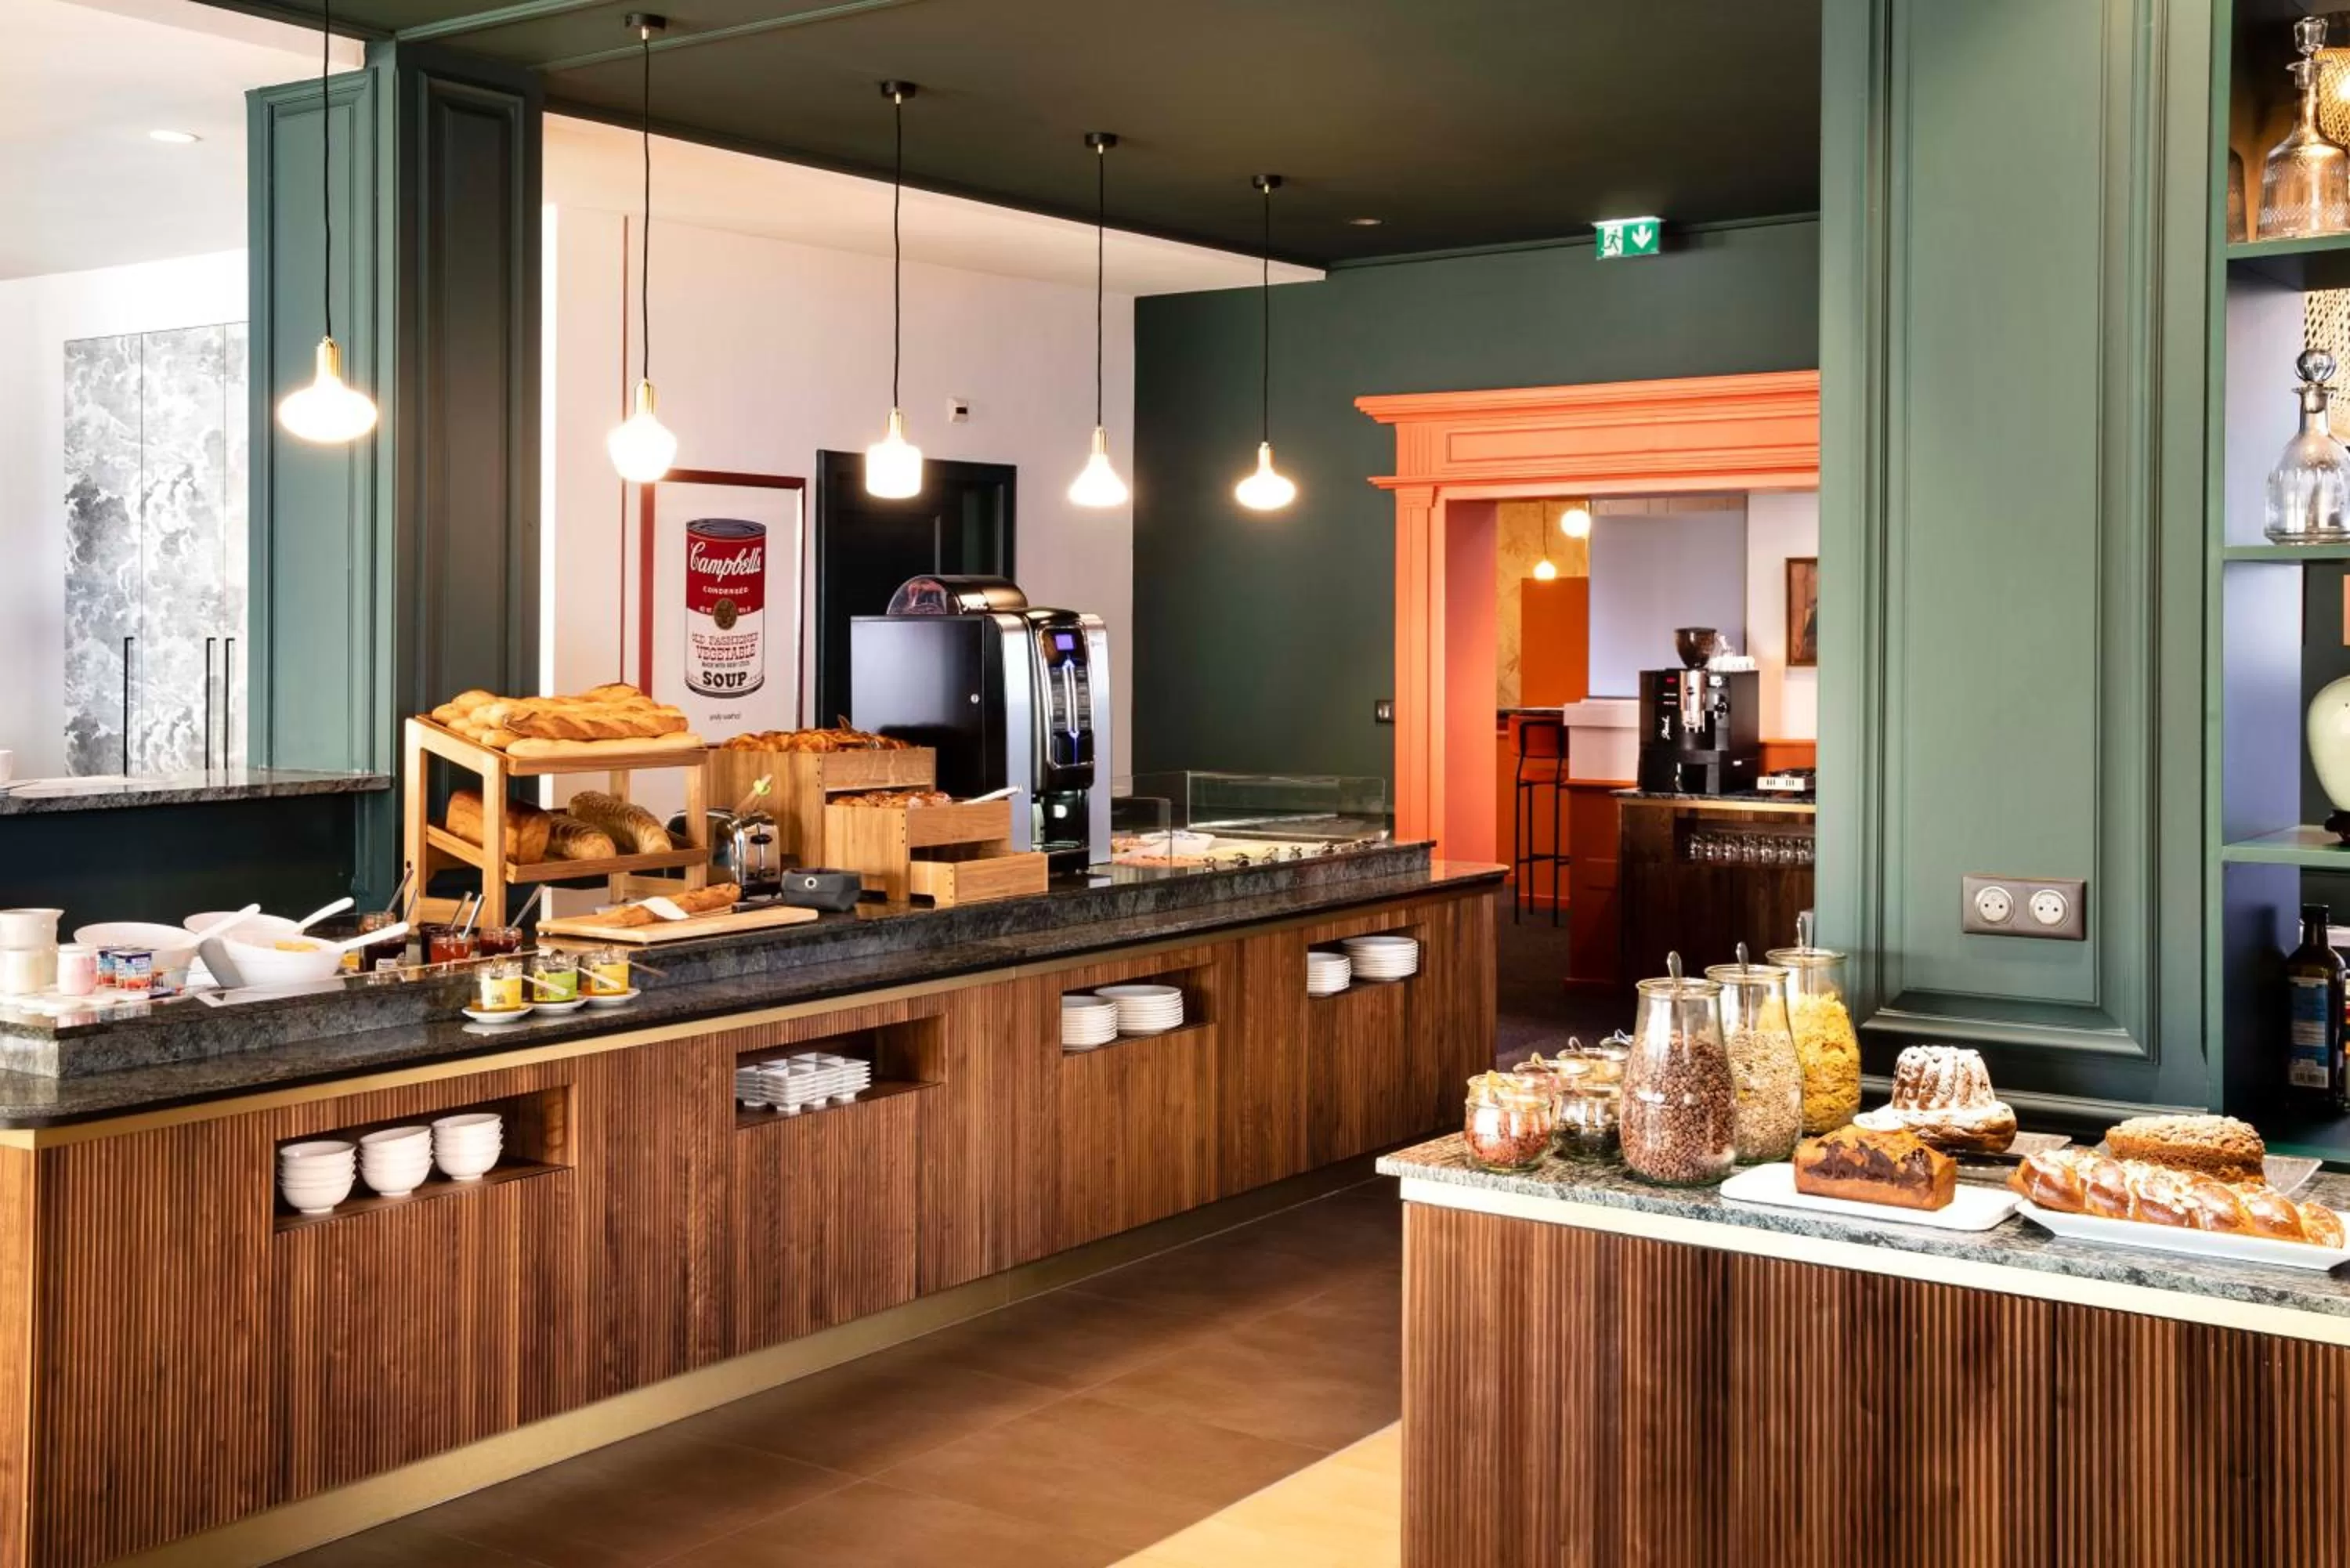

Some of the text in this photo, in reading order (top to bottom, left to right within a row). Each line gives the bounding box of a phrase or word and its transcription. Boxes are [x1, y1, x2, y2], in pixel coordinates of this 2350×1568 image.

[703, 585, 750, 595] CONDENSED
[696, 643, 756, 661] VEGETABLE
[703, 670, 748, 688] SOUP
